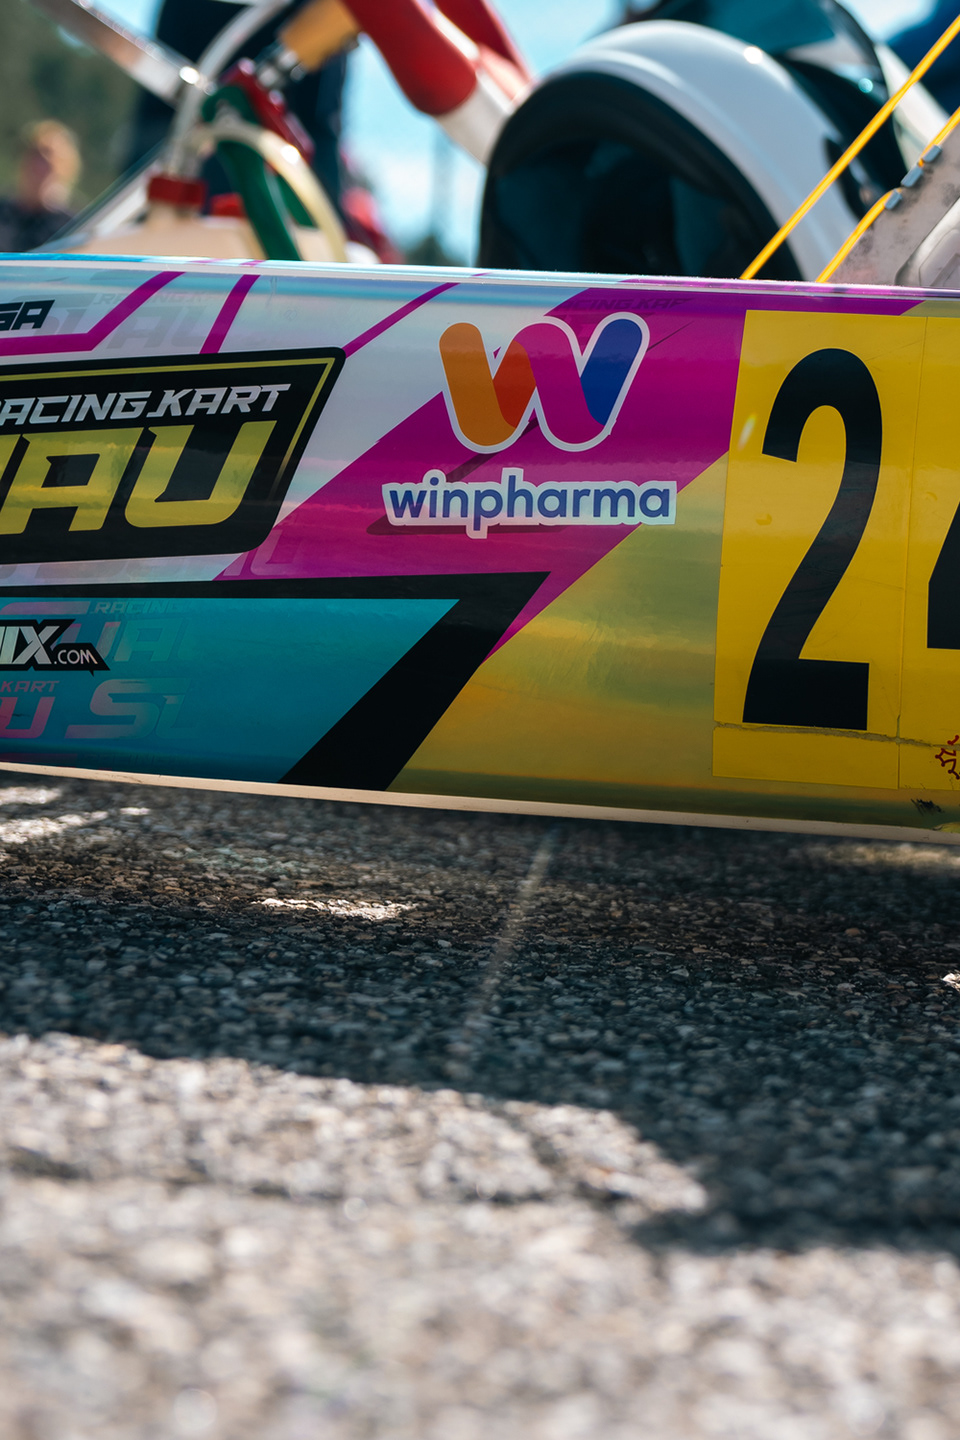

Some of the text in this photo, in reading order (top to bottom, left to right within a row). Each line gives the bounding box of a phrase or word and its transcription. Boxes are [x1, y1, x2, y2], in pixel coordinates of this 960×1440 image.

[0, 383, 291, 427] ACING KART
[388, 474, 671, 532] winpharma
